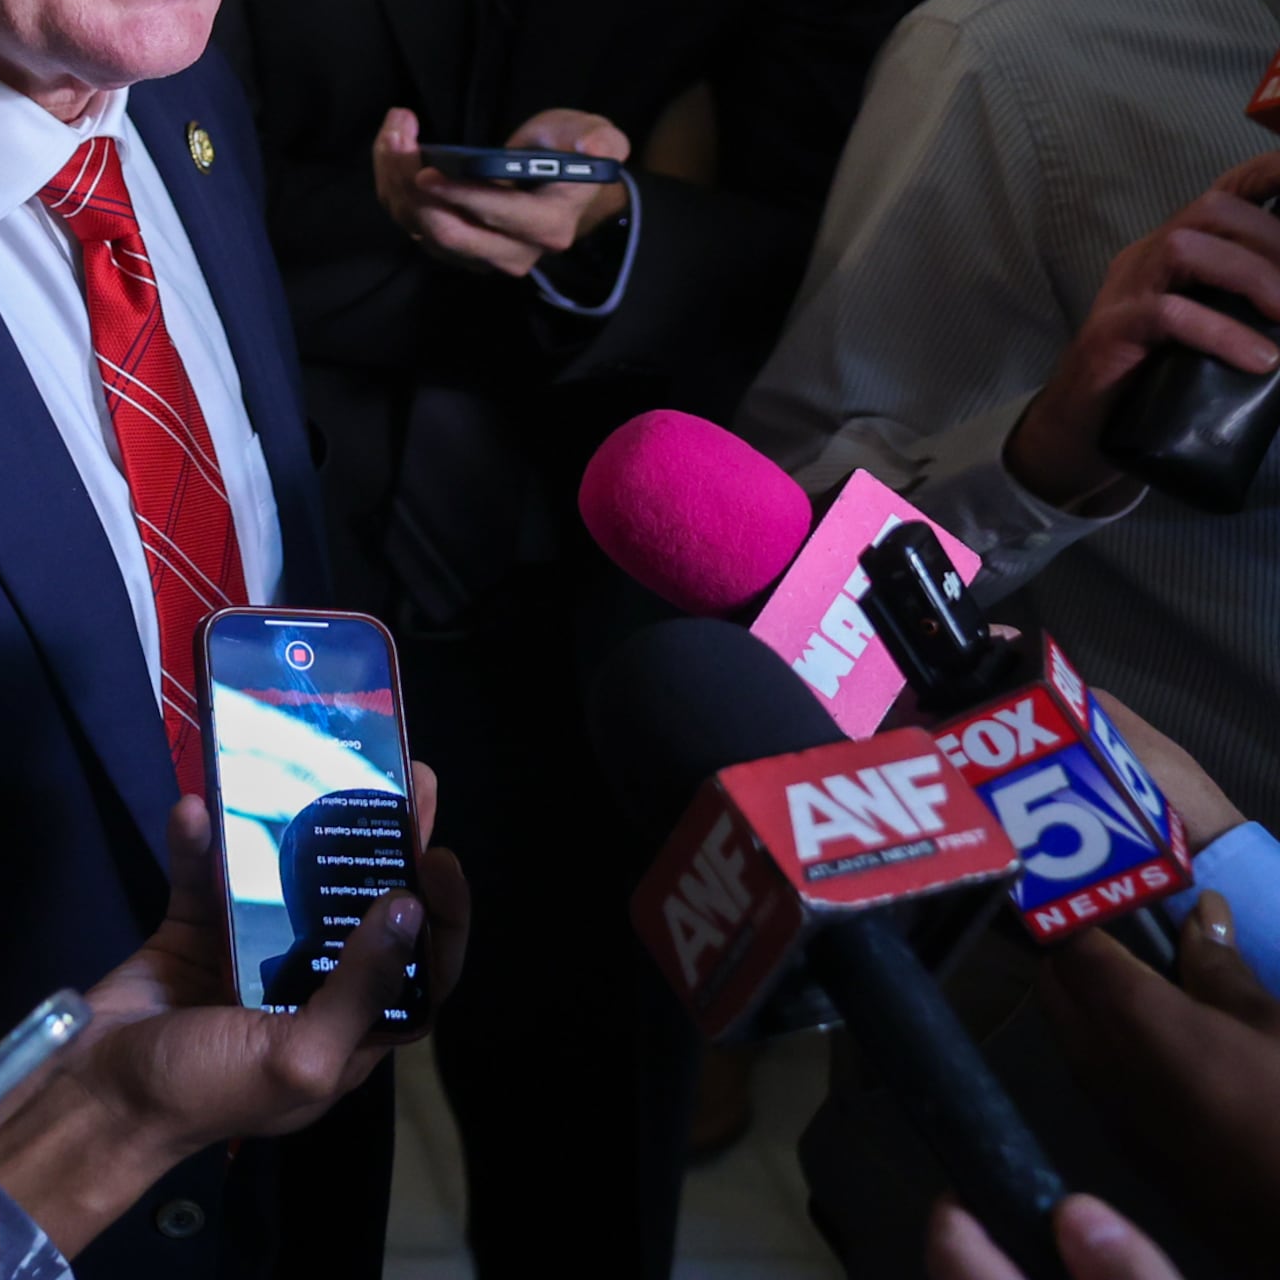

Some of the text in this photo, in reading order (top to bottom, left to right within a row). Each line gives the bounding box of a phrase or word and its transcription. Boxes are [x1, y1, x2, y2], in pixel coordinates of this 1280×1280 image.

[352, 827, 371, 837] State
[372, 827, 401, 838] Georgia
[786, 753, 948, 861] ANF
[992, 764, 1111, 880] 5
[354, 857, 374, 866] State
[375, 857, 405, 867] Georgia
[808, 827, 986, 880] ATLANTA NEWS FIRST
[662, 809, 751, 989] ANF
[1035, 866, 1170, 931] NEWS
